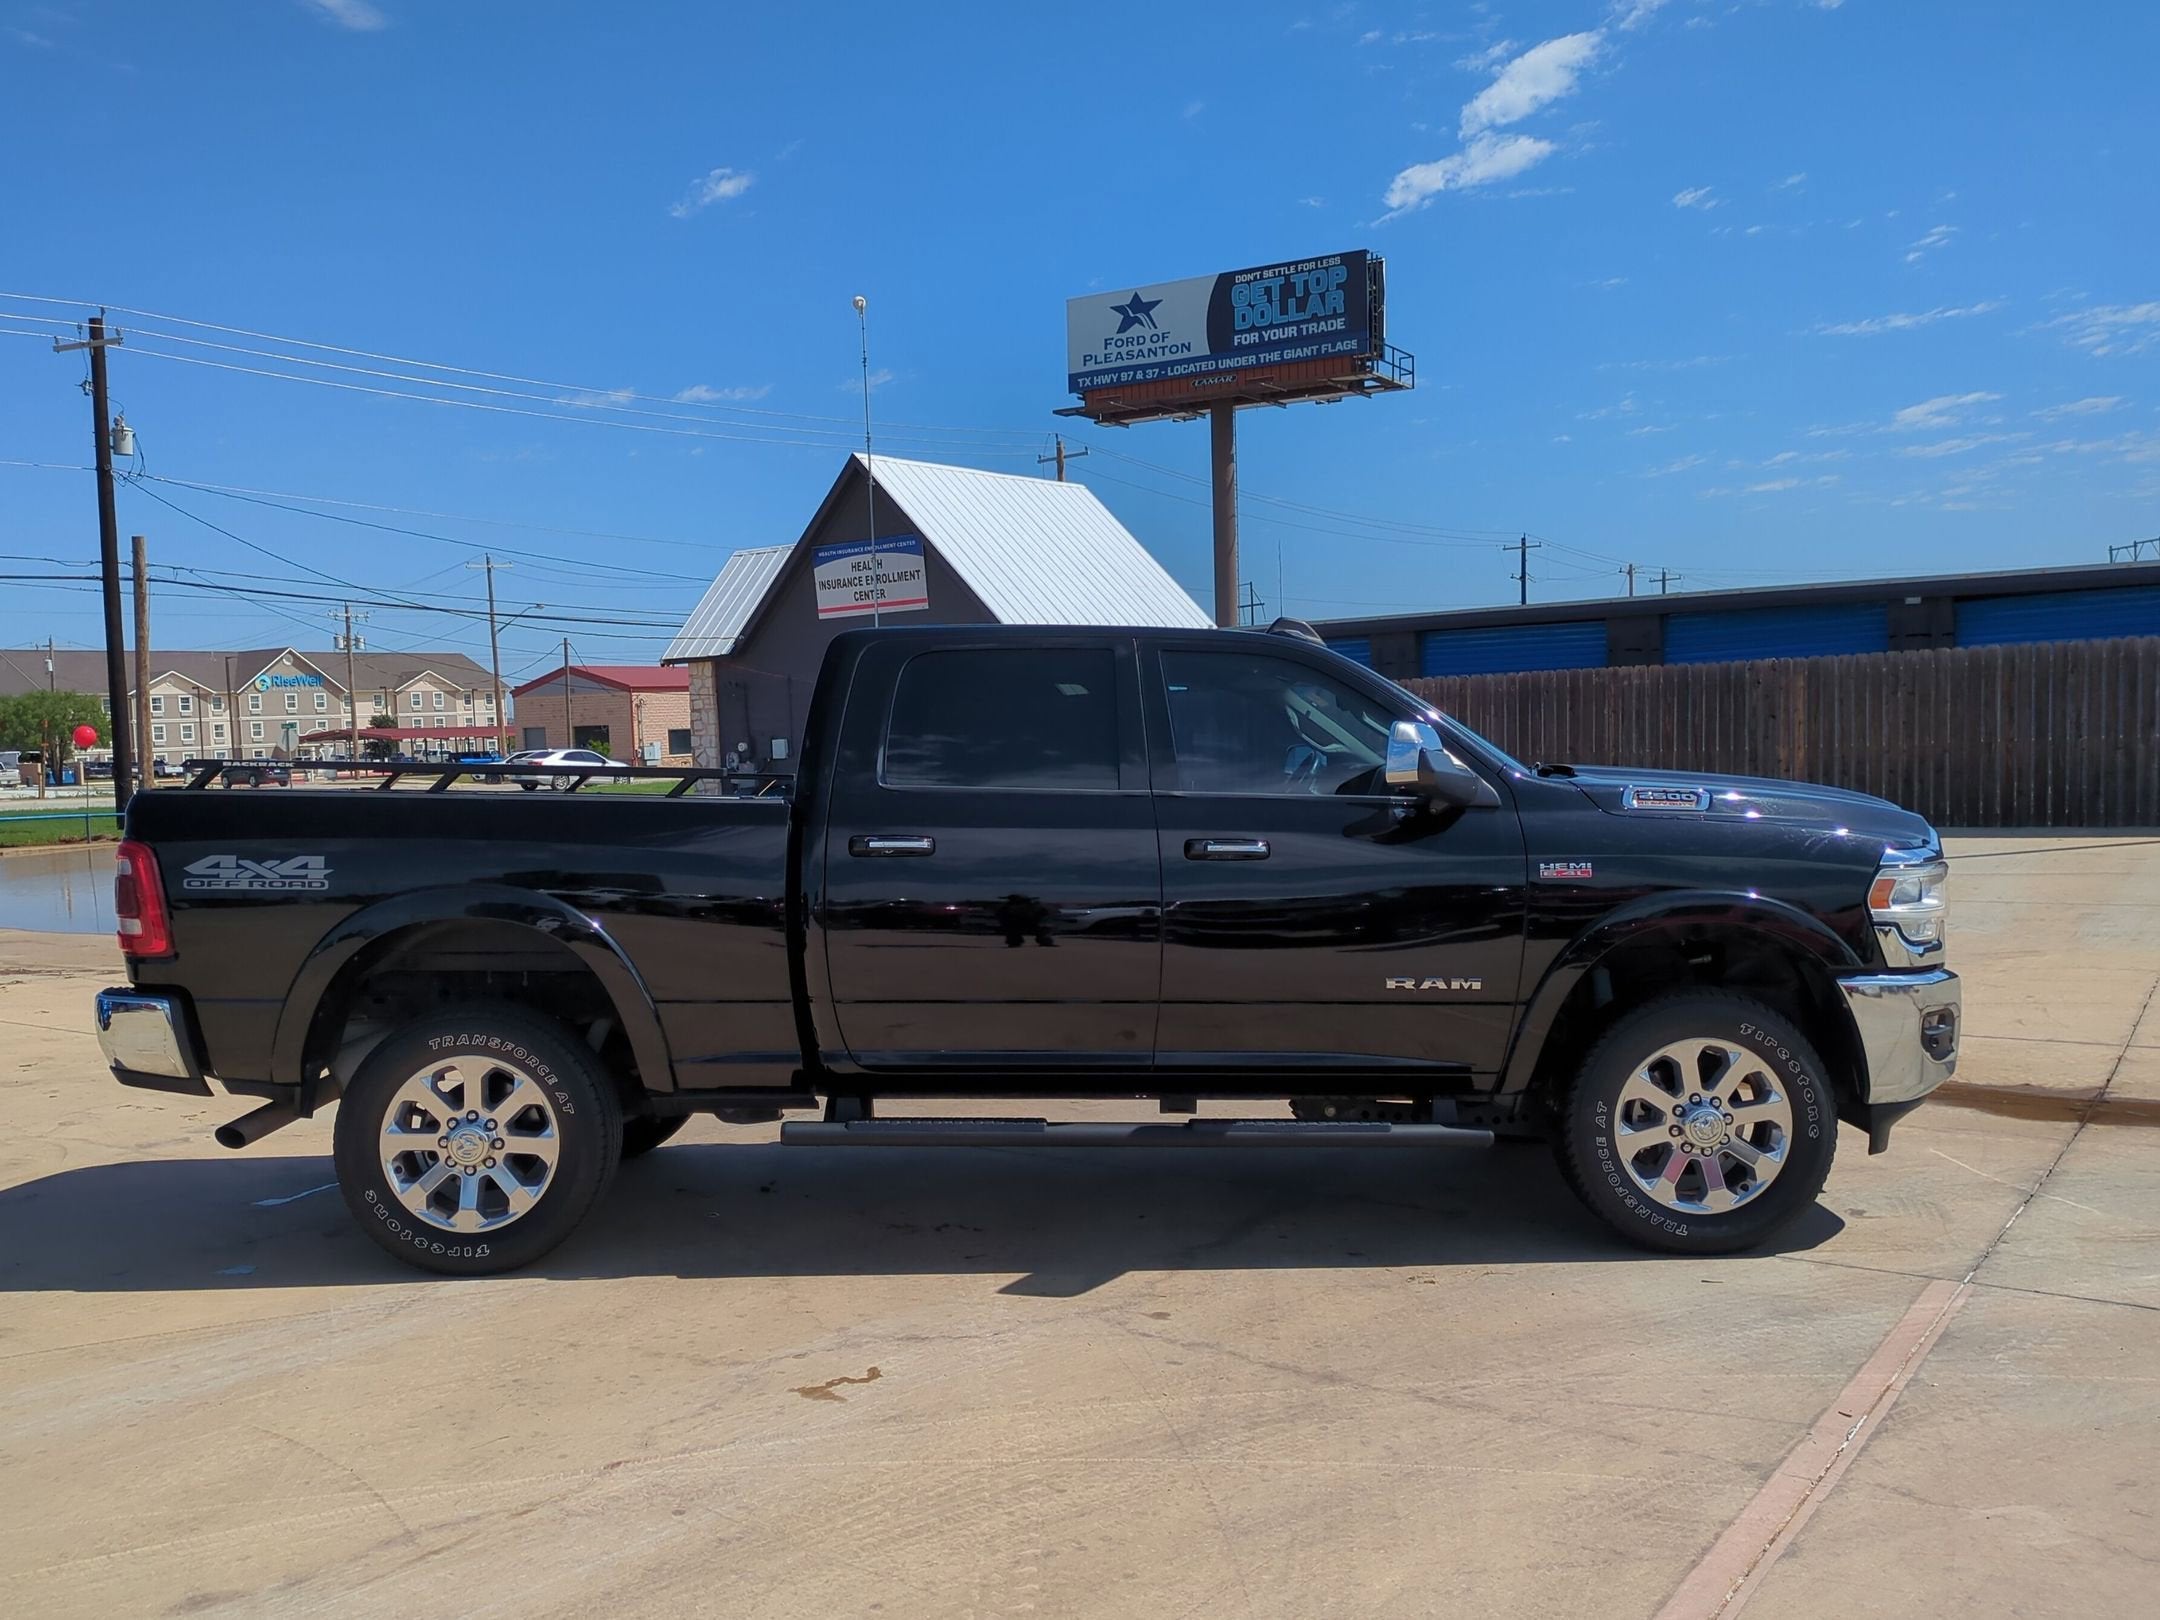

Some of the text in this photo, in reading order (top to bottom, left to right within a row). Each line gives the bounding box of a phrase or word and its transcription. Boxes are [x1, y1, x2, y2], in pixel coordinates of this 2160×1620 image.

[1235, 256, 1341, 283] DON'T SETTLE FOR LESS
[1231, 265, 1347, 307] GET TOP
[1234, 289, 1344, 330] DOLLAR
[1104, 331, 1171, 350] FORD OF
[1234, 318, 1345, 346] FOR YOUR TRADE
[1077, 377, 1092, 388] TX
[1093, 373, 1119, 385] HWY
[1120, 371, 1134, 382] 97
[1136, 370, 1143, 380] &
[1146, 368, 1159, 379] 37
[1167, 361, 1215, 376] LOCATED
[1218, 356, 1256, 369] UNDER
[1259, 352, 1281, 363] THE
[1284, 345, 1319, 360] GIANT
[1321, 339, 1358, 355] FLAGS
[1083, 342, 1191, 367] PLEASANTON
[864, 542, 896, 552] ENOLLMENT
[851, 559, 883, 573] HEALH
[818, 576, 863, 591] INSURANCE
[853, 588, 887, 602] CENTER
[186, 879, 326, 889] OFF ROAD
[1385, 977, 1482, 990] RAM
[429, 1034, 574, 1114] TRANSFORCE AT
[1596, 1101, 1688, 1236] TRANSFORCE AT
